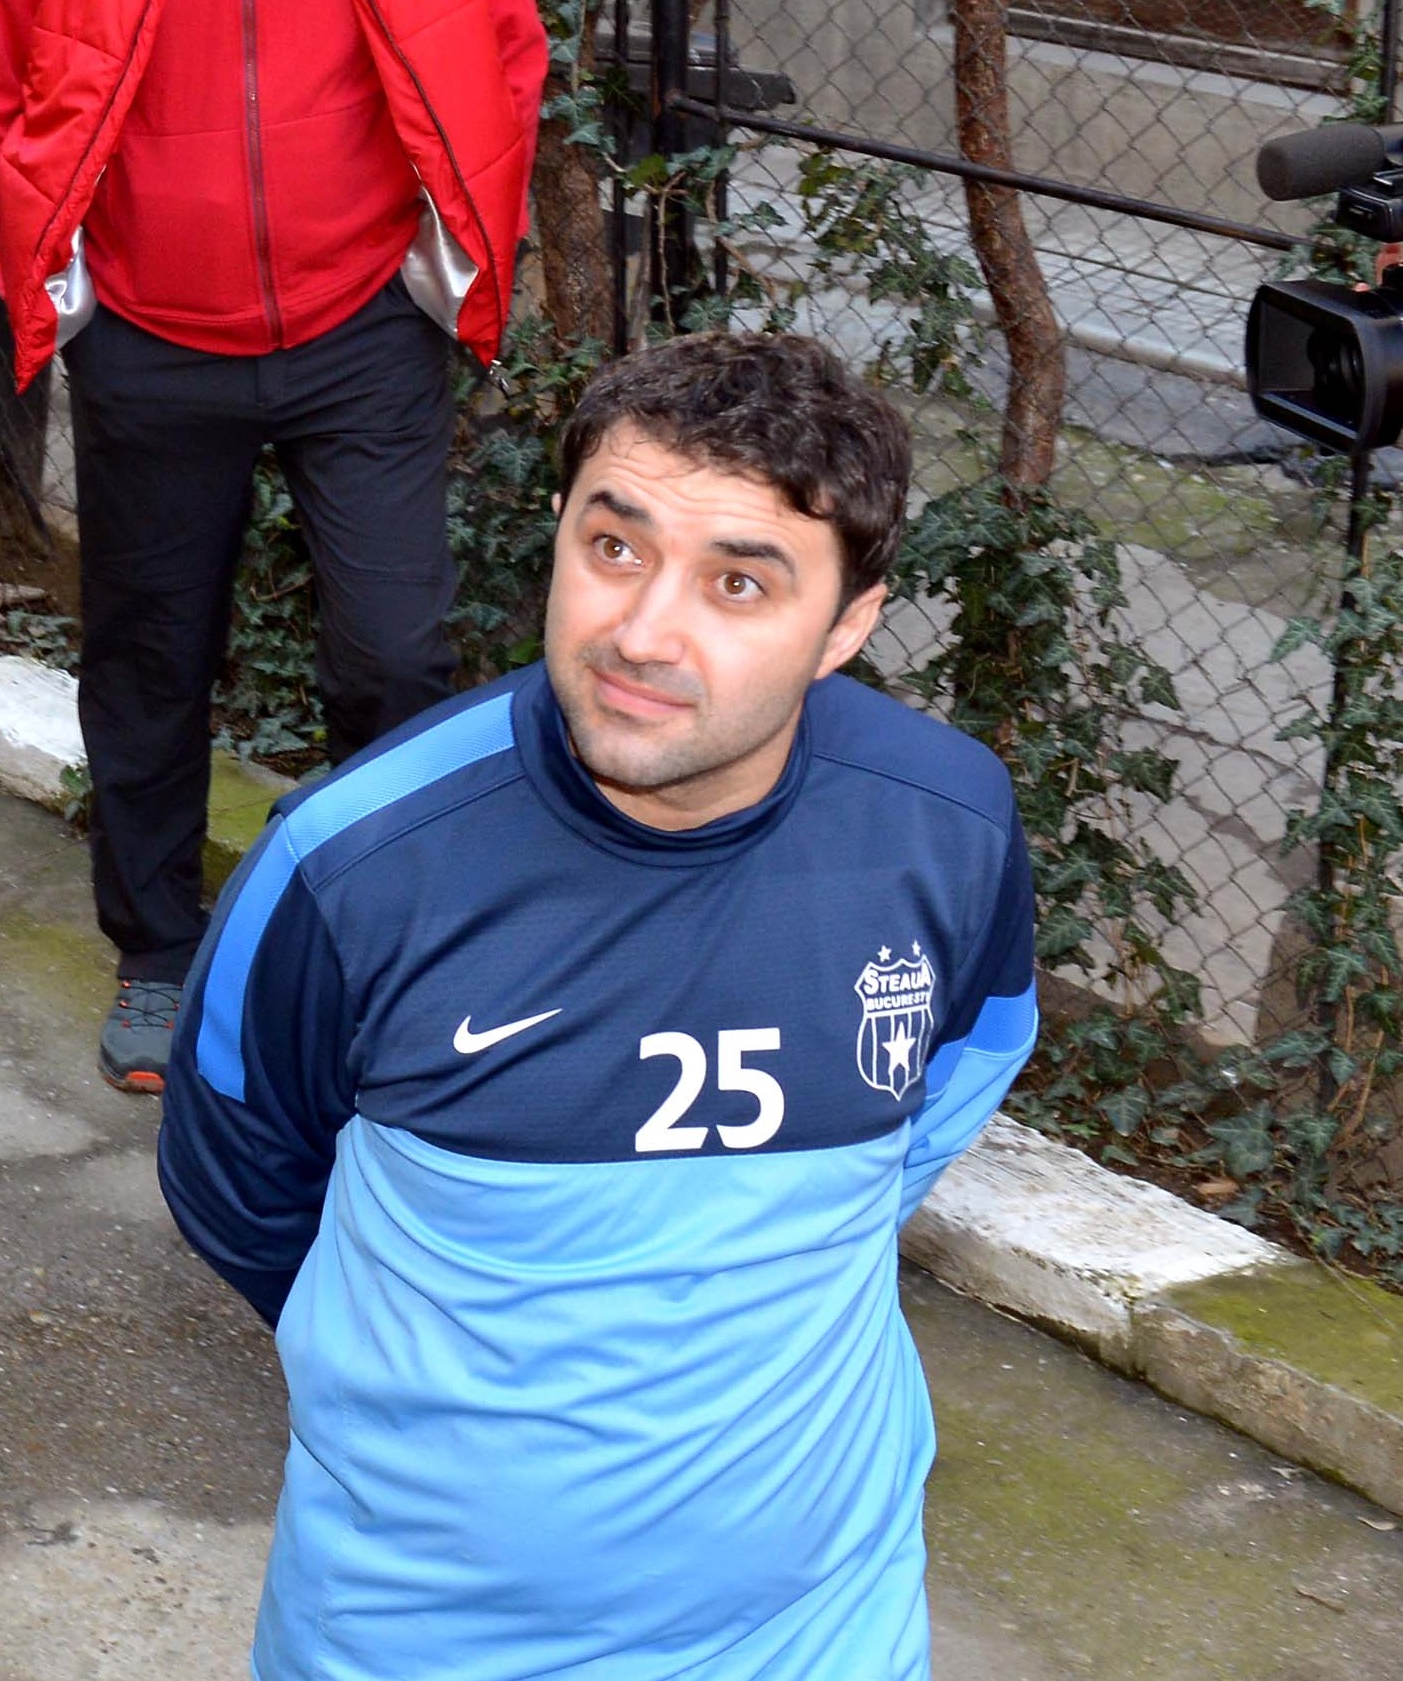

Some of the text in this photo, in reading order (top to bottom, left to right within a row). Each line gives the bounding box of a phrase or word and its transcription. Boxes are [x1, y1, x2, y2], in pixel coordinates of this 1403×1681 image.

[863, 962, 932, 995] STEAUA
[866, 991, 932, 1011] BUCURESTI
[635, 1028, 785, 1152] 25
